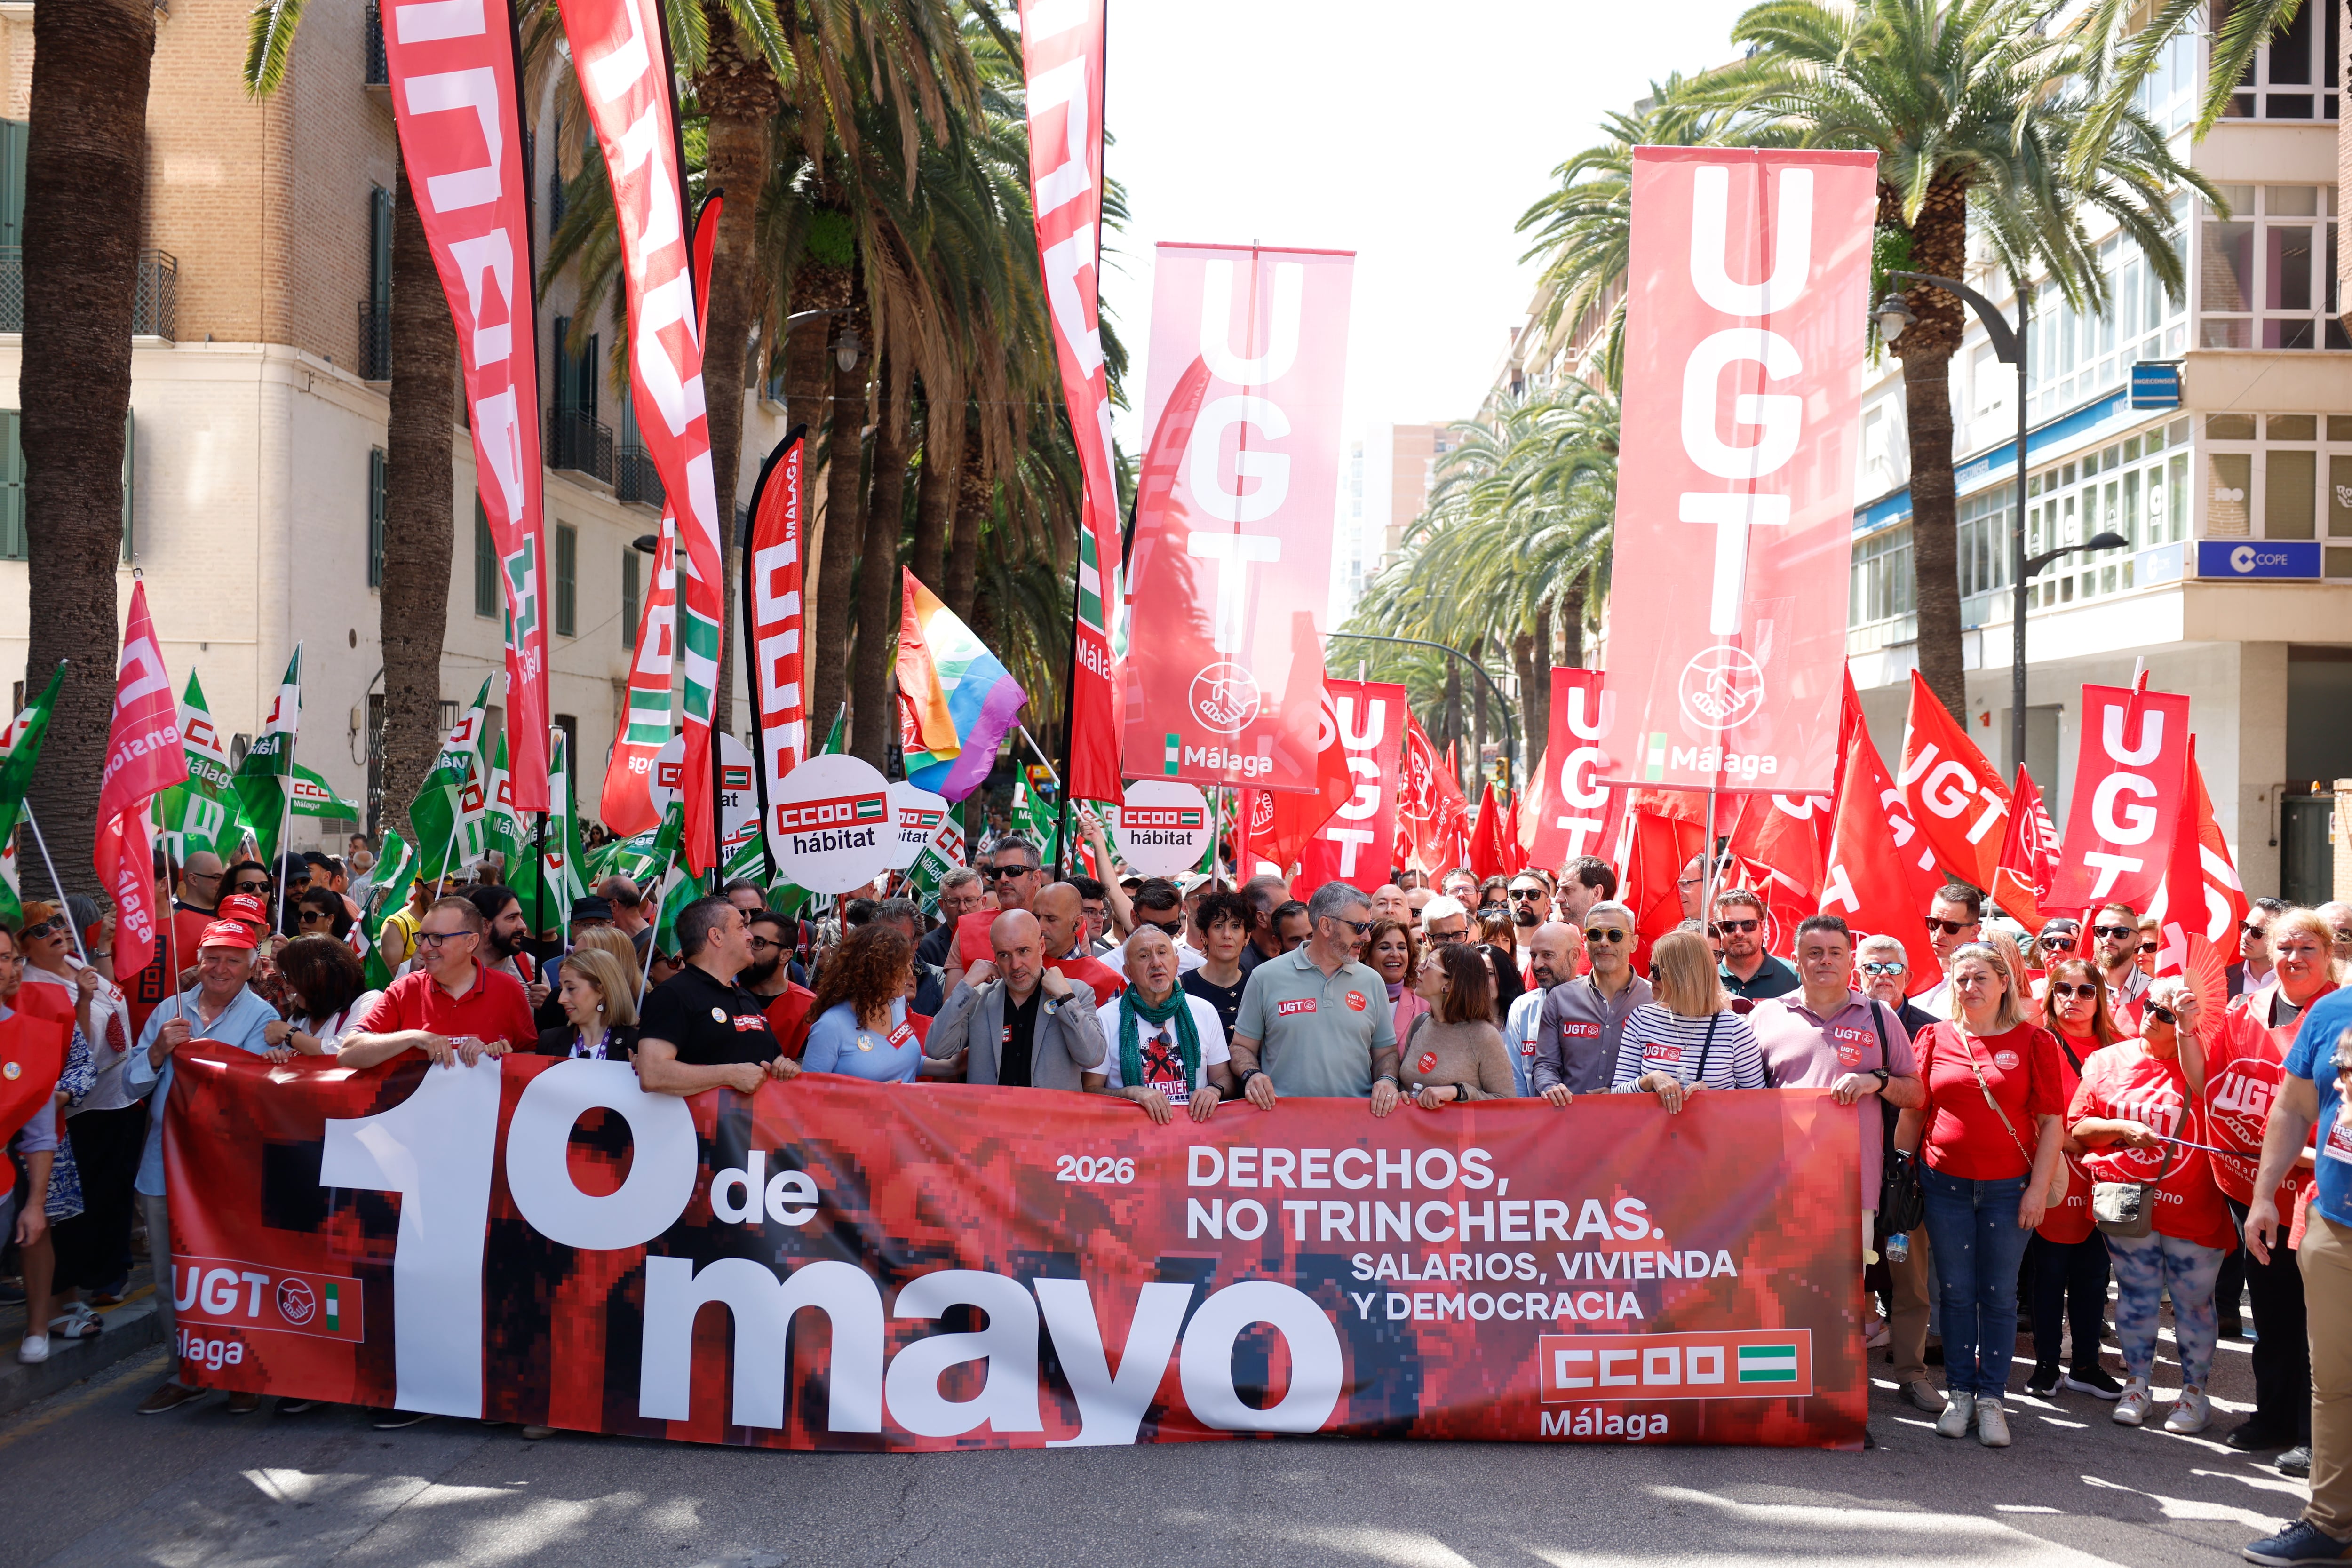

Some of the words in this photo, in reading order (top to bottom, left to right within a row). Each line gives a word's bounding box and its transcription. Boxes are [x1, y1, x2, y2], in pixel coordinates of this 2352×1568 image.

[1679, 166, 1814, 635] UGT
[1187, 258, 1304, 654] UGT
[1954, 458, 1989, 486] NGECONSER
[786, 449, 799, 539] MÁLAGA
[2257, 553, 2288, 566] COPE
[1076, 635, 1111, 680] Mála
[1184, 745, 1273, 778] Málaga
[1557, 686, 1616, 862] UGT
[1670, 746, 1777, 780] Málaga
[1327, 696, 1386, 878] UGT
[1897, 723, 2010, 845] UGT
[294, 799, 320, 811] Málaga
[782, 803, 852, 827] CCOO
[1124, 811, 1177, 824] CCOO
[2083, 704, 2164, 899] UGT
[793, 828, 875, 854] hábitat
[1131, 830, 1192, 845] hábitat
[1279, 1001, 1303, 1014] UGT
[1564, 1024, 1587, 1034] UGT
[1834, 1027, 1861, 1041] UGT
[1423, 1054, 1433, 1063] UGT
[1645, 1046, 1668, 1057] UGT
[1056, 1155, 1135, 1184] 2026
[1187, 1146, 1510, 1197] DERECHOS,
[710, 1150, 819, 1225] de
[1187, 1198, 1268, 1241] NO
[1283, 1197, 1665, 1243] TRINCHERAS.
[1351, 1252, 1547, 1285] SALARIOS,
[1557, 1250, 1738, 1279] VIVIENDA
[171, 1264, 270, 1319] UGT
[1350, 1292, 1376, 1321] Y
[1386, 1291, 1644, 1321] DEMOCRACIA
[639, 1254, 1343, 1448] mayo
[1554, 1345, 1724, 1389] CCOO
[1540, 1407, 1669, 1442] Málaga
